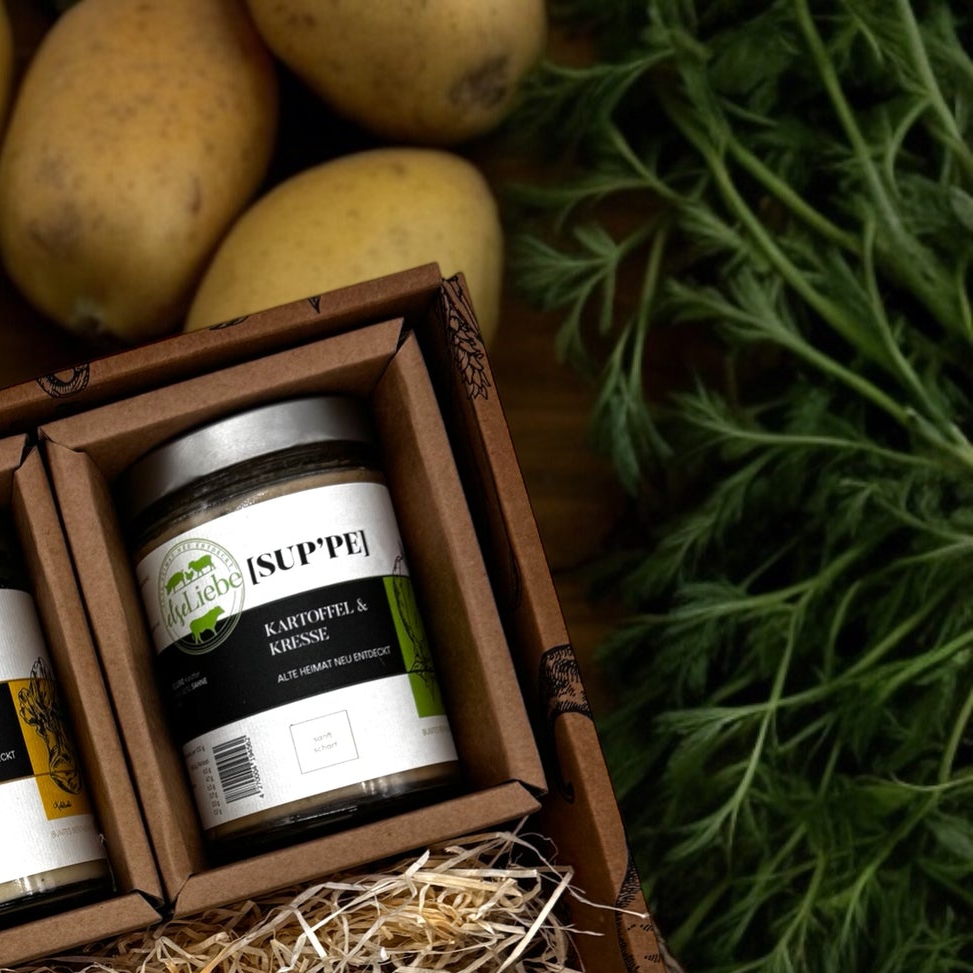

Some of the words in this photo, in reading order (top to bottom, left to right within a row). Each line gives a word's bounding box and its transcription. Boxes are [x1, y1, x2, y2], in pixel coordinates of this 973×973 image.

[264, 601, 354, 637] KARTOFFEL
[357, 597, 369, 613] &
[269, 627, 330, 656] KRESSE
[277, 668, 299, 683] ALTE
[299, 659, 333, 677] HEIMAT
[333, 654, 353, 667] NEU
[353, 645, 391, 662] ENTDECKT
